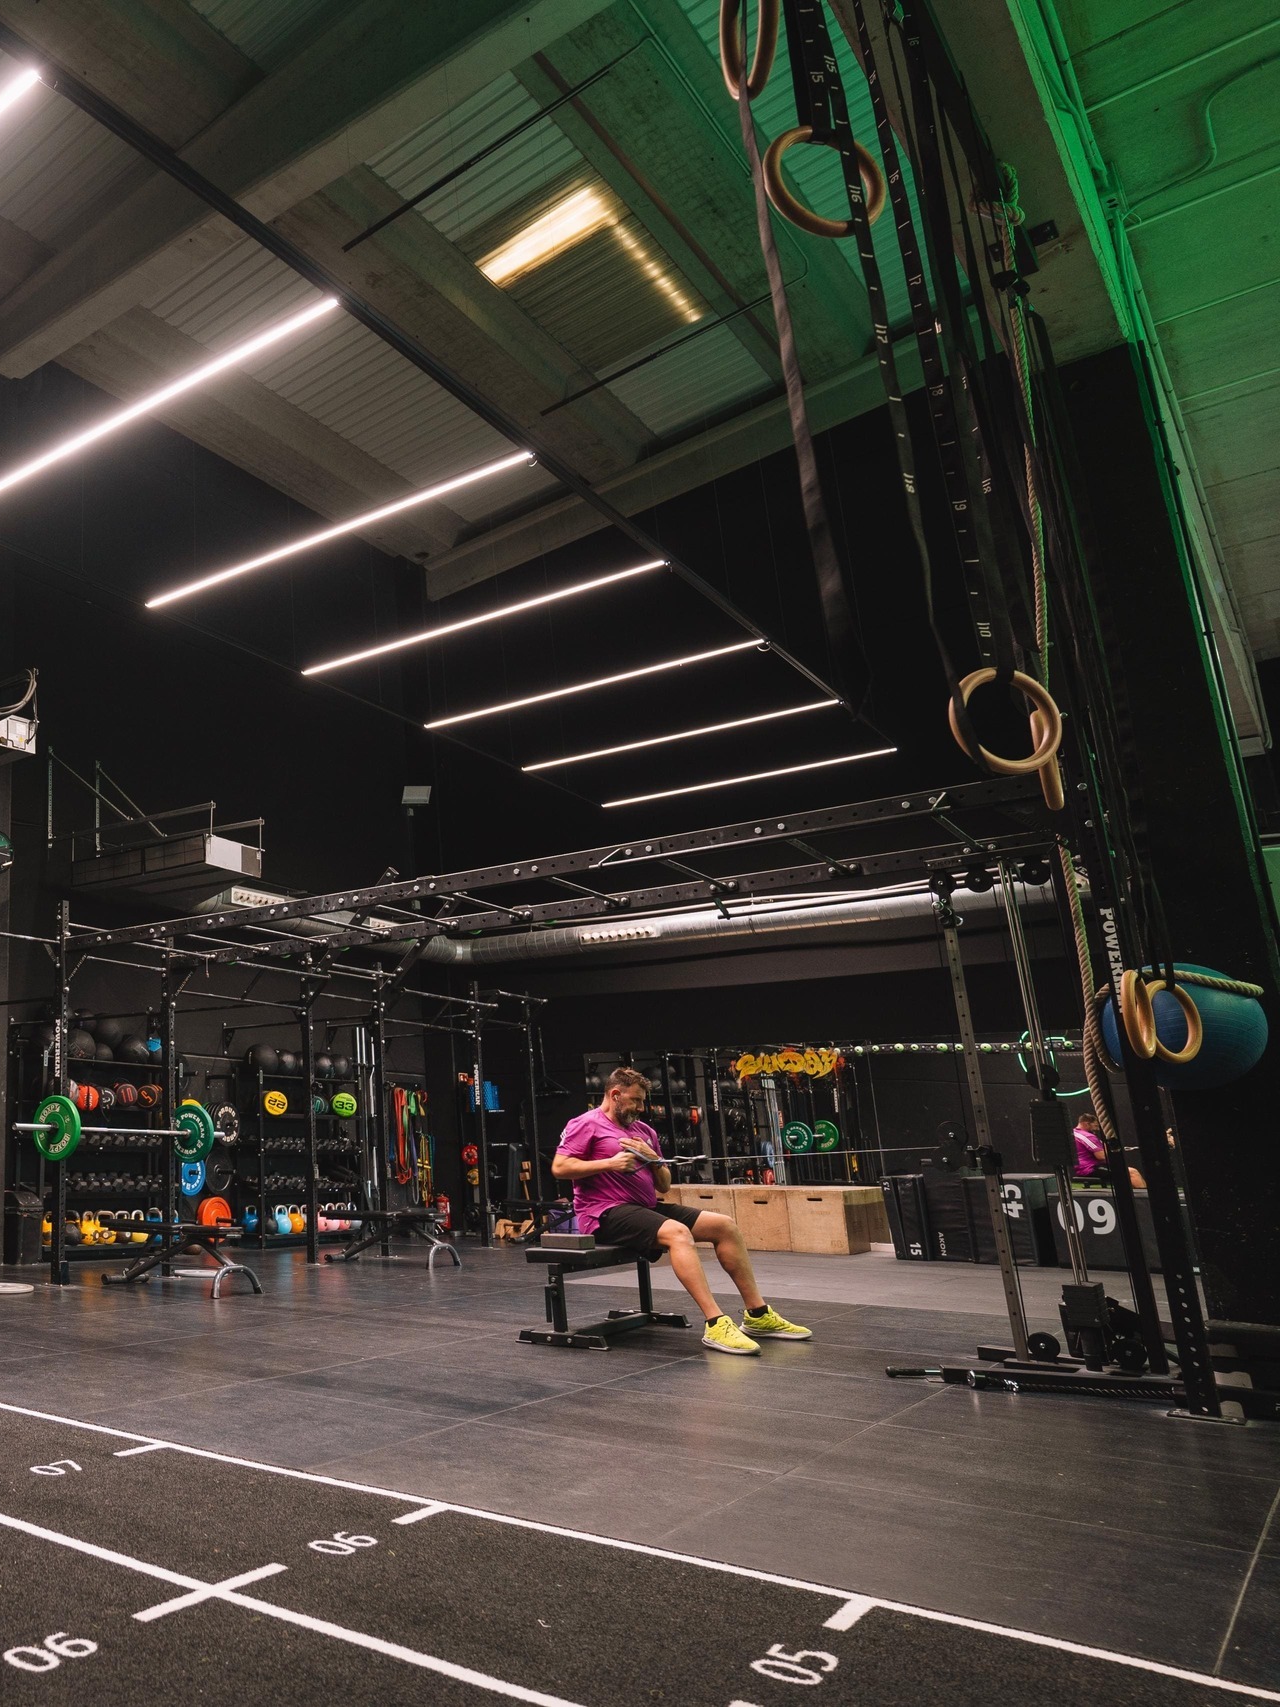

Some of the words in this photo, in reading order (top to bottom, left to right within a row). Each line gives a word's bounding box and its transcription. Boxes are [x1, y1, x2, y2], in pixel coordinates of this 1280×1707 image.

[1100, 907, 1124, 1014] POWER
[121, 1087, 134, 1103] 10
[335, 1100, 355, 1111] 33
[910, 1242, 922, 1256] 15
[938, 1231, 947, 1256] AKON
[29, 1459, 83, 1476] 07
[308, 1531, 379, 1556] 06
[2, 1631, 98, 1673] 06
[750, 1643, 839, 1685] 05
